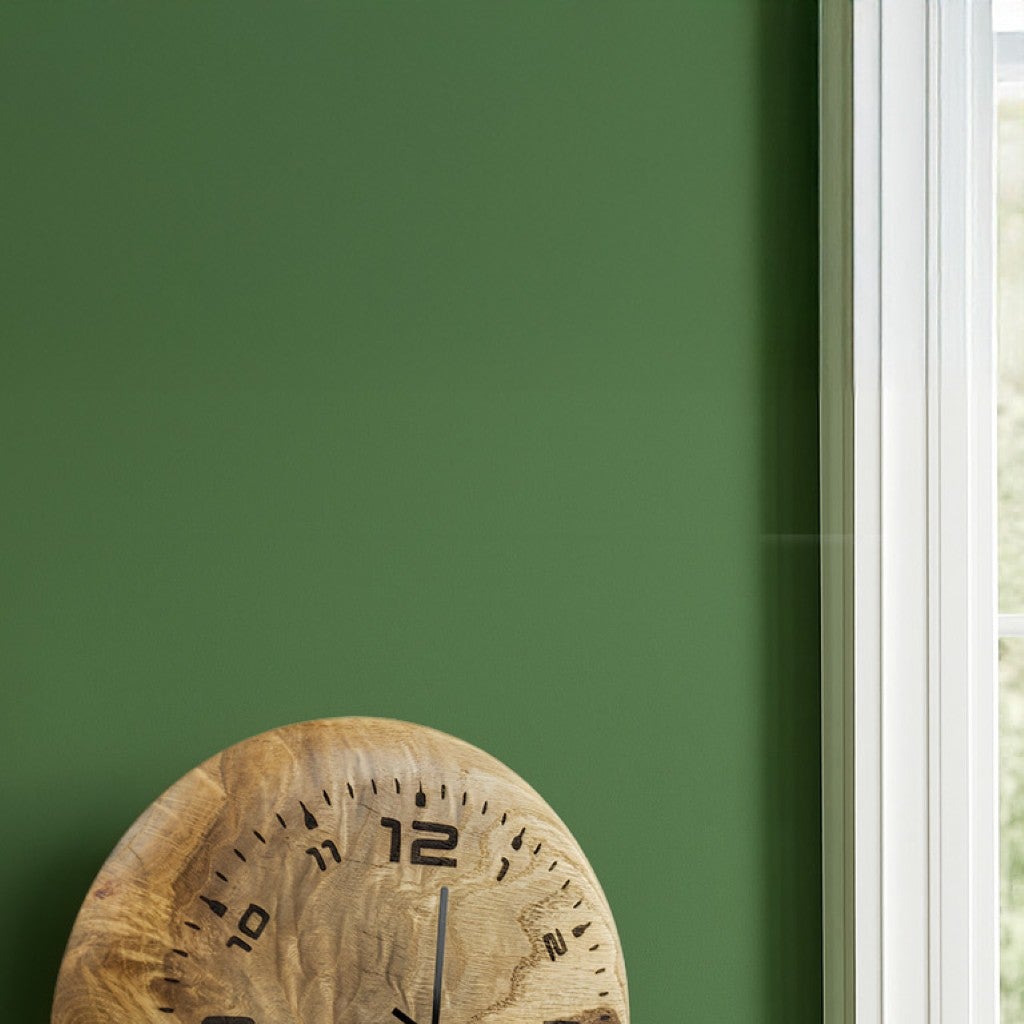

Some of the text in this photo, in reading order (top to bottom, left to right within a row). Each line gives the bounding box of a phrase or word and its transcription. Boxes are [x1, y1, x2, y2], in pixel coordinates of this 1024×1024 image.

[305, 839, 342, 871] 11
[380, 816, 458, 868] 12
[496, 857, 510, 881] 1
[225, 903, 270, 953] 10
[543, 928, 568, 962] 2
